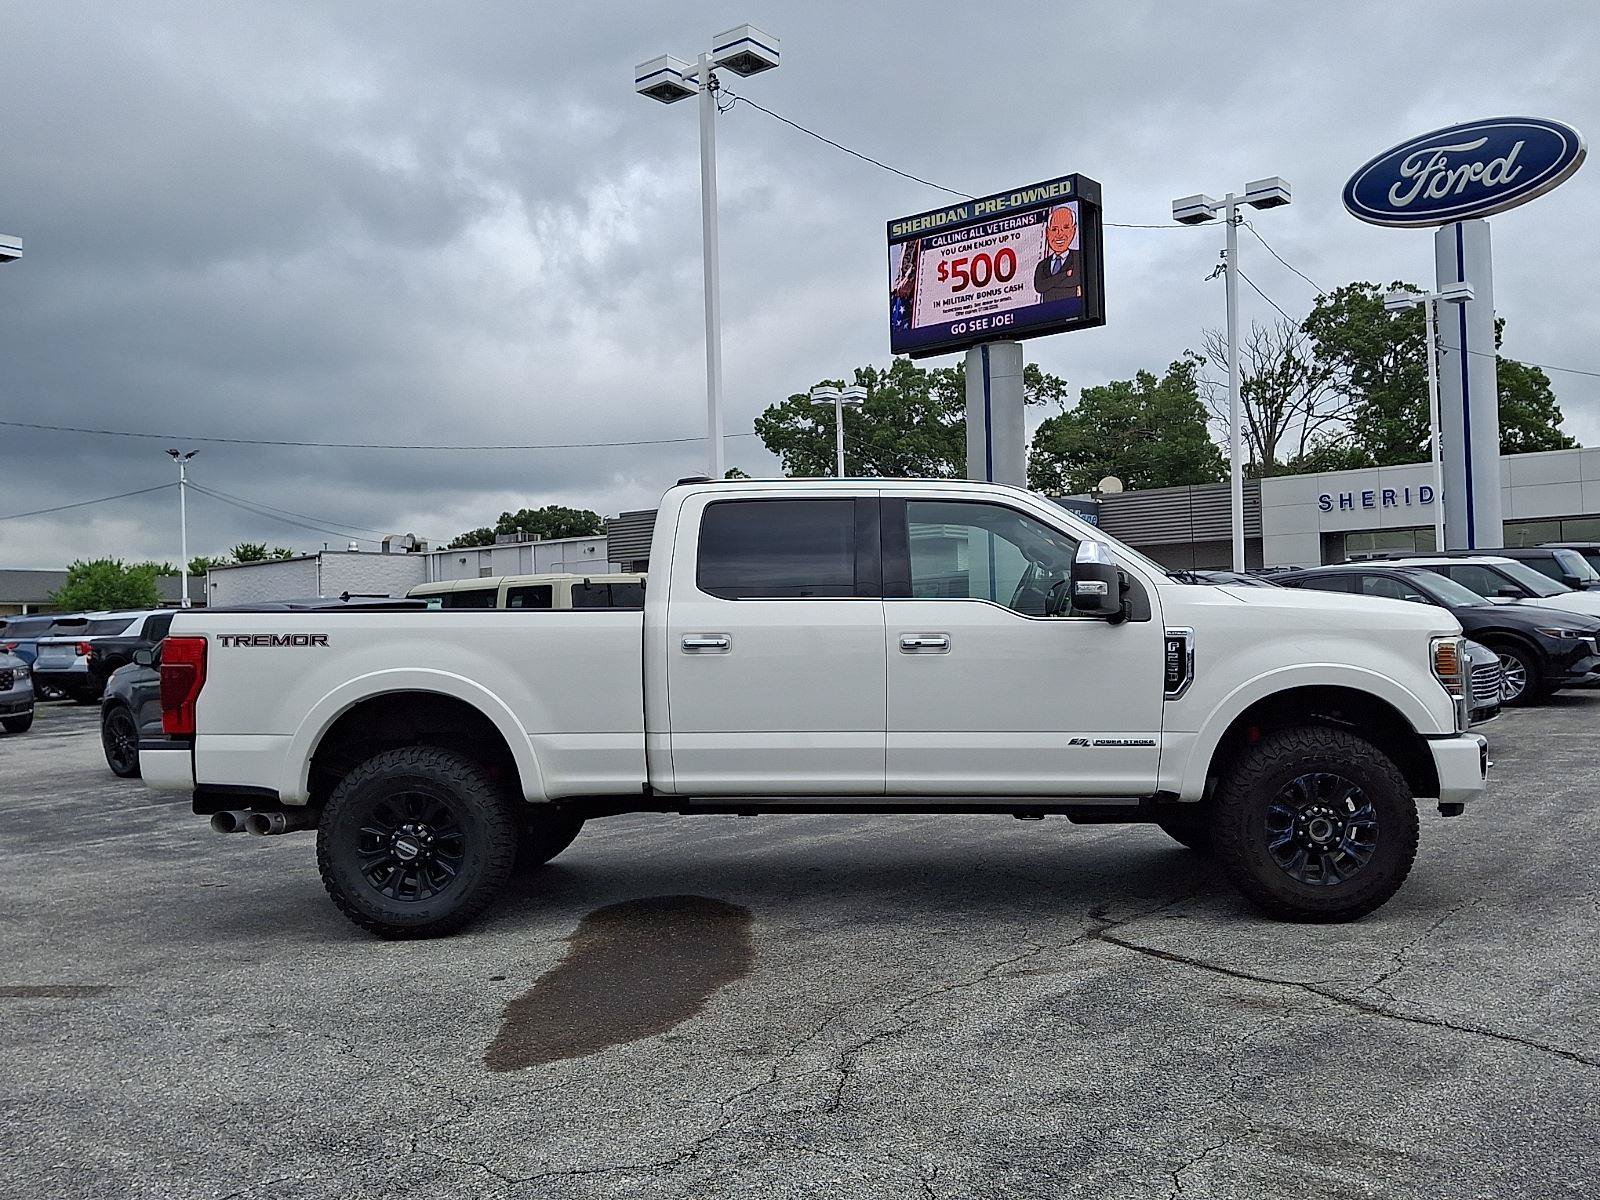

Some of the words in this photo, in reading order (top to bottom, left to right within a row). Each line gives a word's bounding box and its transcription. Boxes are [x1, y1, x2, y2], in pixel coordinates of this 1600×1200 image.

[1388, 136, 1525, 207] Ford
[892, 207, 968, 236] SHERIDAN
[974, 180, 1071, 216] PRE-OWNED
[932, 230, 967, 246] CALLING
[969, 226, 985, 240] ALL
[987, 213, 1037, 234] VETERANS!
[941, 247, 956, 256] YOU
[958, 243, 972, 252] CAN
[974, 238, 997, 249] ENJOY
[998, 234, 1009, 243] UP
[1010, 232, 1021, 241] TO
[937, 248, 1017, 293] $500
[943, 293, 974, 306] MILITARY
[976, 287, 1002, 299] BONUS
[1003, 283, 1024, 294] CASH
[951, 322, 967, 335] GO
[969, 318, 989, 331] SEE
[991, 313, 1014, 328] JOE!
[1318, 485, 1445, 512] SHERID
[216, 633, 330, 648] TREMOR
